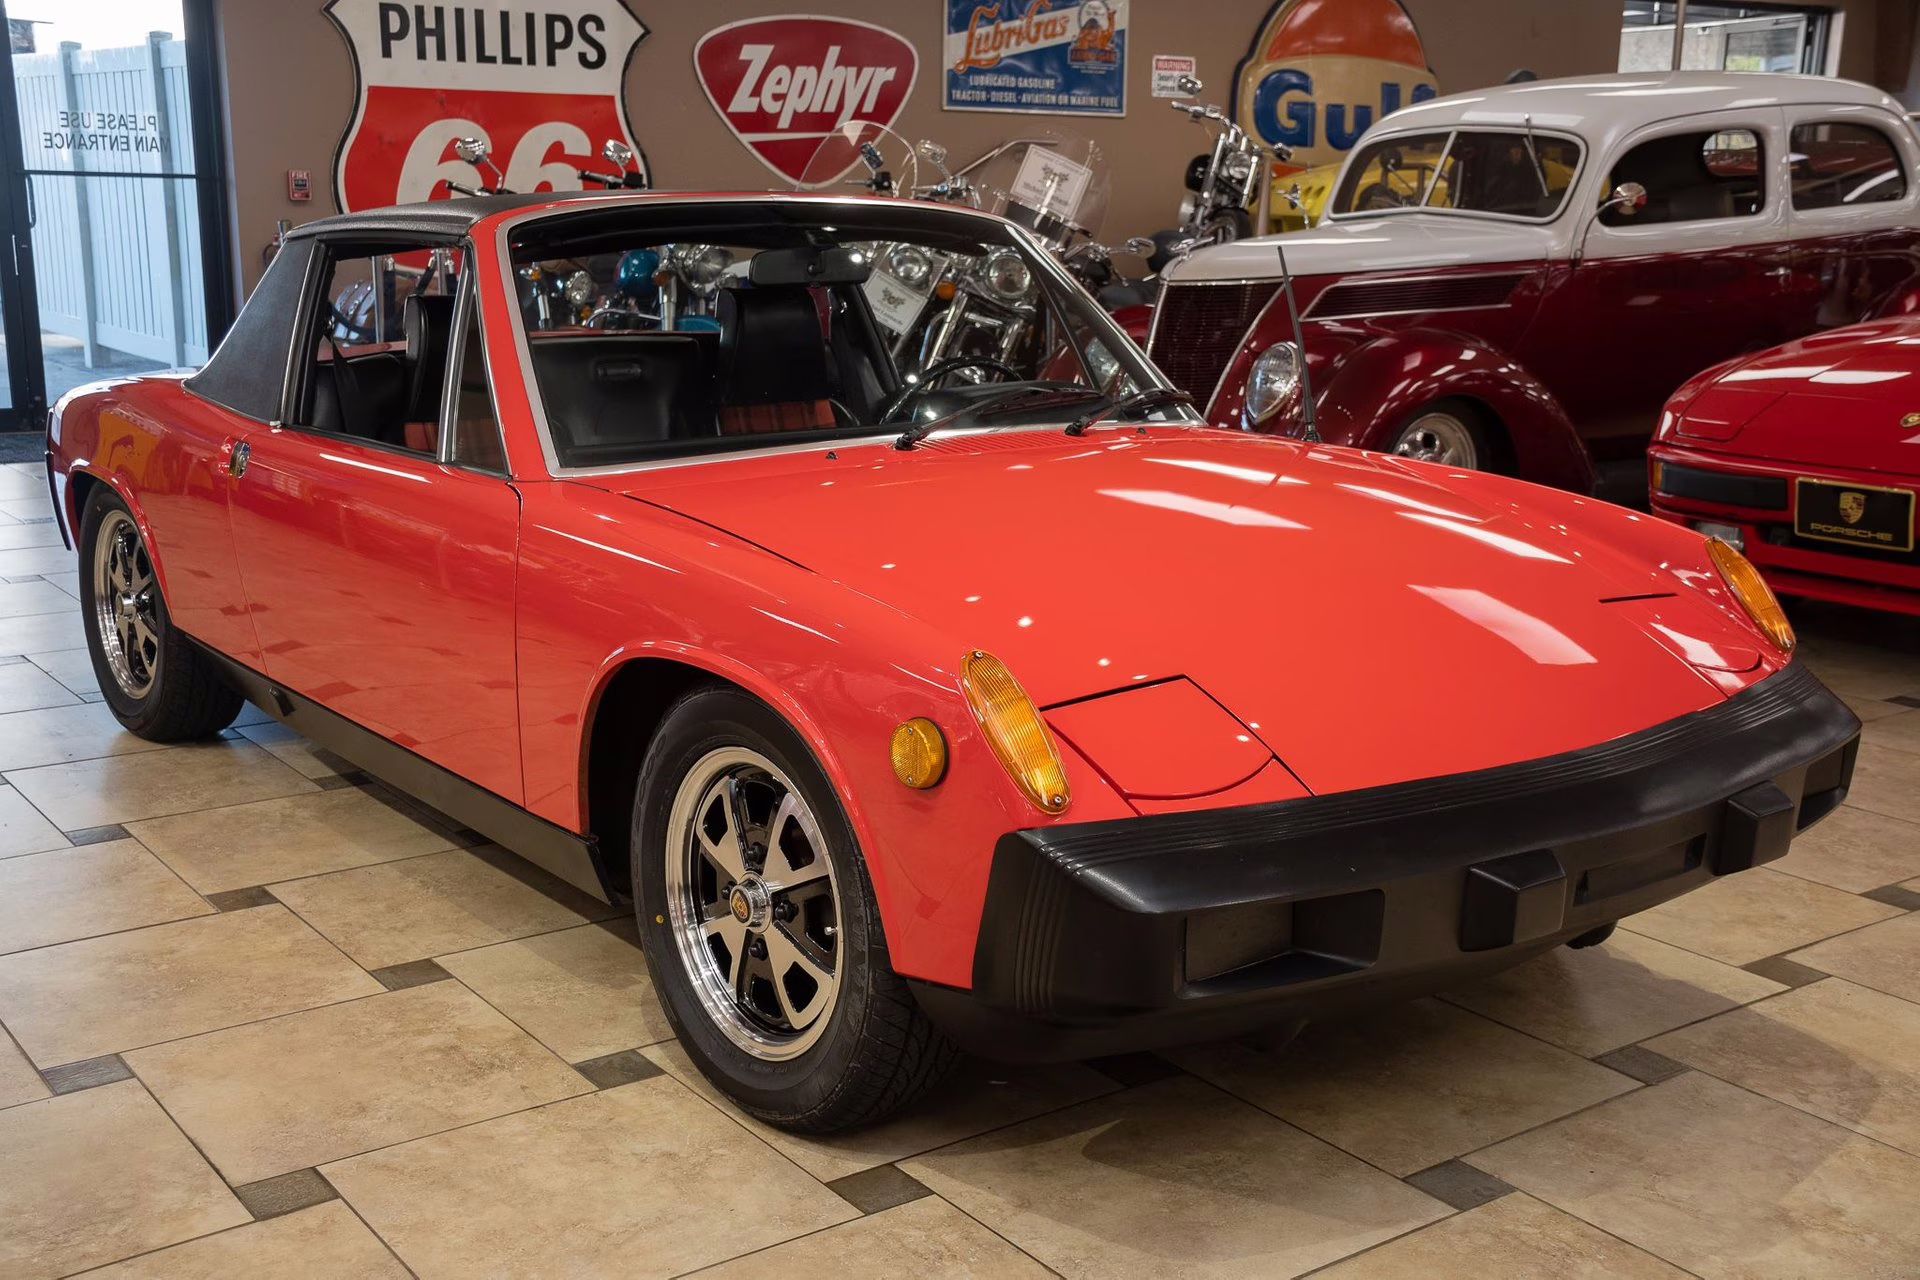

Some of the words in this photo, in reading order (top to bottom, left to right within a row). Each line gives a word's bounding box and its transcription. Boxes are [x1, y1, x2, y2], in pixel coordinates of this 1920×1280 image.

[379, 2, 607, 70] PHILLIPS
[727, 44, 897, 129] Zephyr
[952, 89, 987, 102] TRACTOR
[990, 91, 1018, 103] DIESEL
[1021, 93, 1057, 105] AVIATION
[1058, 94, 1069, 106] OR
[1070, 95, 1099, 107] MARINE
[1100, 96, 1118, 108] FUEL
[969, 74, 1016, 88] LUBRICATED
[1017, 76, 1056, 90] GASOLINE
[1253, 69, 1437, 152] Gu
[1810, 522, 1893, 541] PORSCHE
